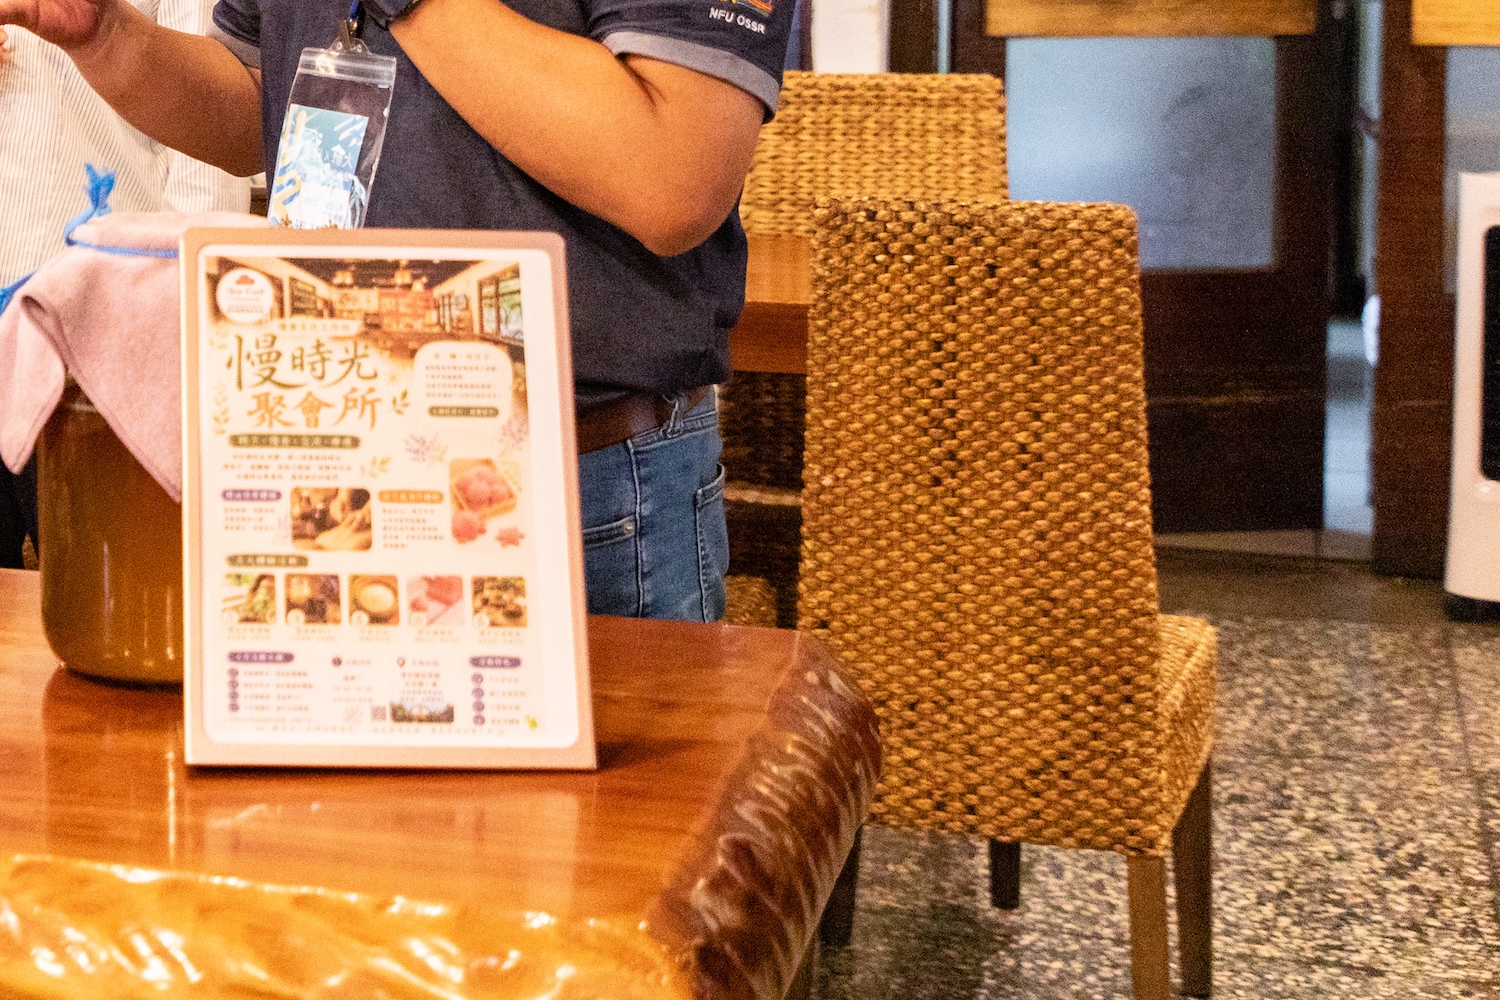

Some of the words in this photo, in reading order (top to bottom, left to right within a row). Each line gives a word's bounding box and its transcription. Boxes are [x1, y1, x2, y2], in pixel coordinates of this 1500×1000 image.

[709, 6, 734, 23] NFU
[737, 15, 766, 34] OSSR
[226, 333, 378, 392] 慢時光
[247, 386, 382, 432] 聚會所
